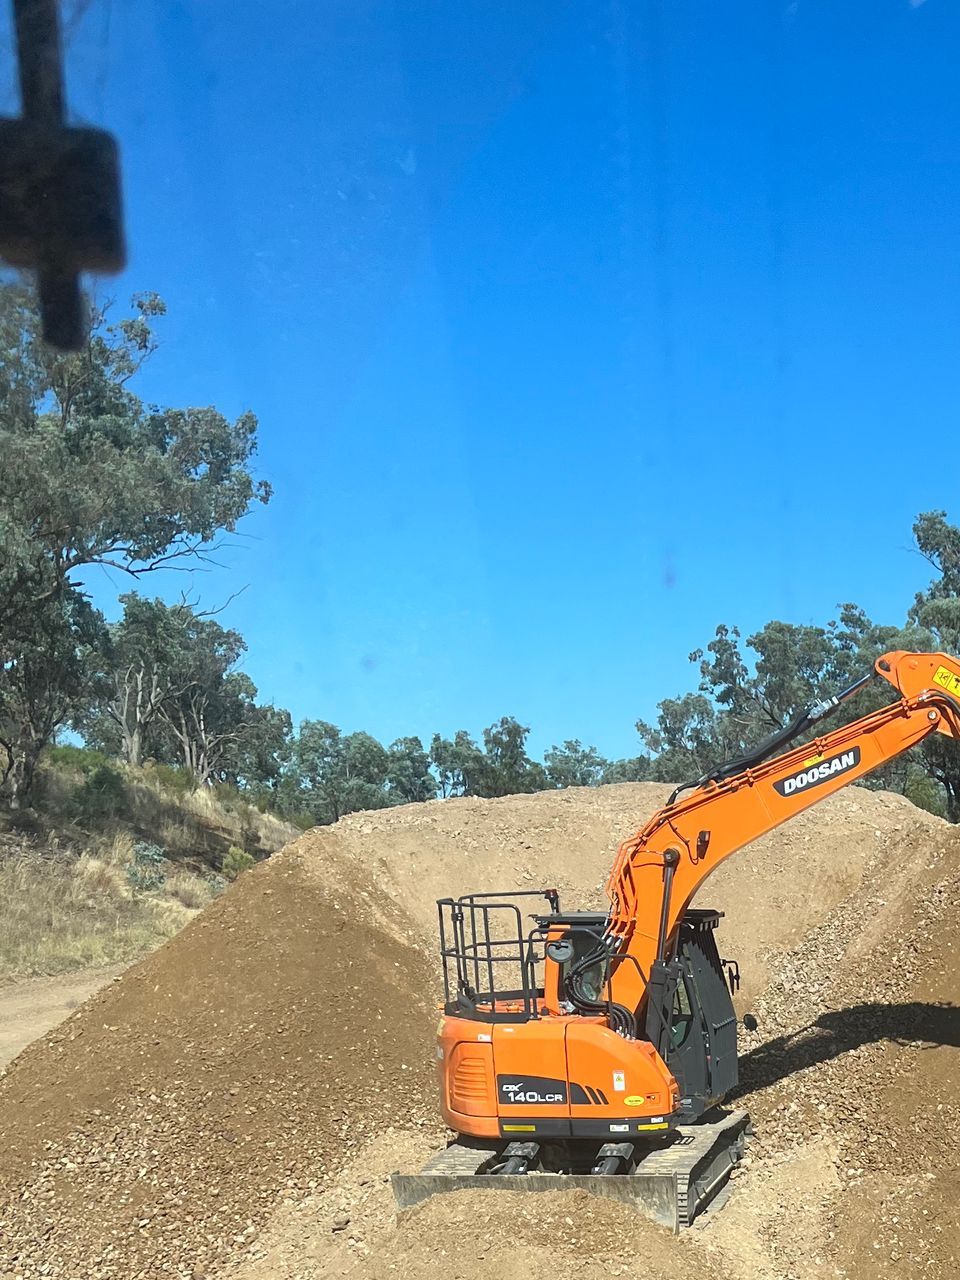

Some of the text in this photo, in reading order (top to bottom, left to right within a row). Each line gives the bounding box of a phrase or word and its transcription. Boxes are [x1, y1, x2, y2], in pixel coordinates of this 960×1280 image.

[784, 751, 855, 794] DOOSAN
[502, 1083, 523, 1092] DX
[508, 1091, 563, 1102] 140LCR
